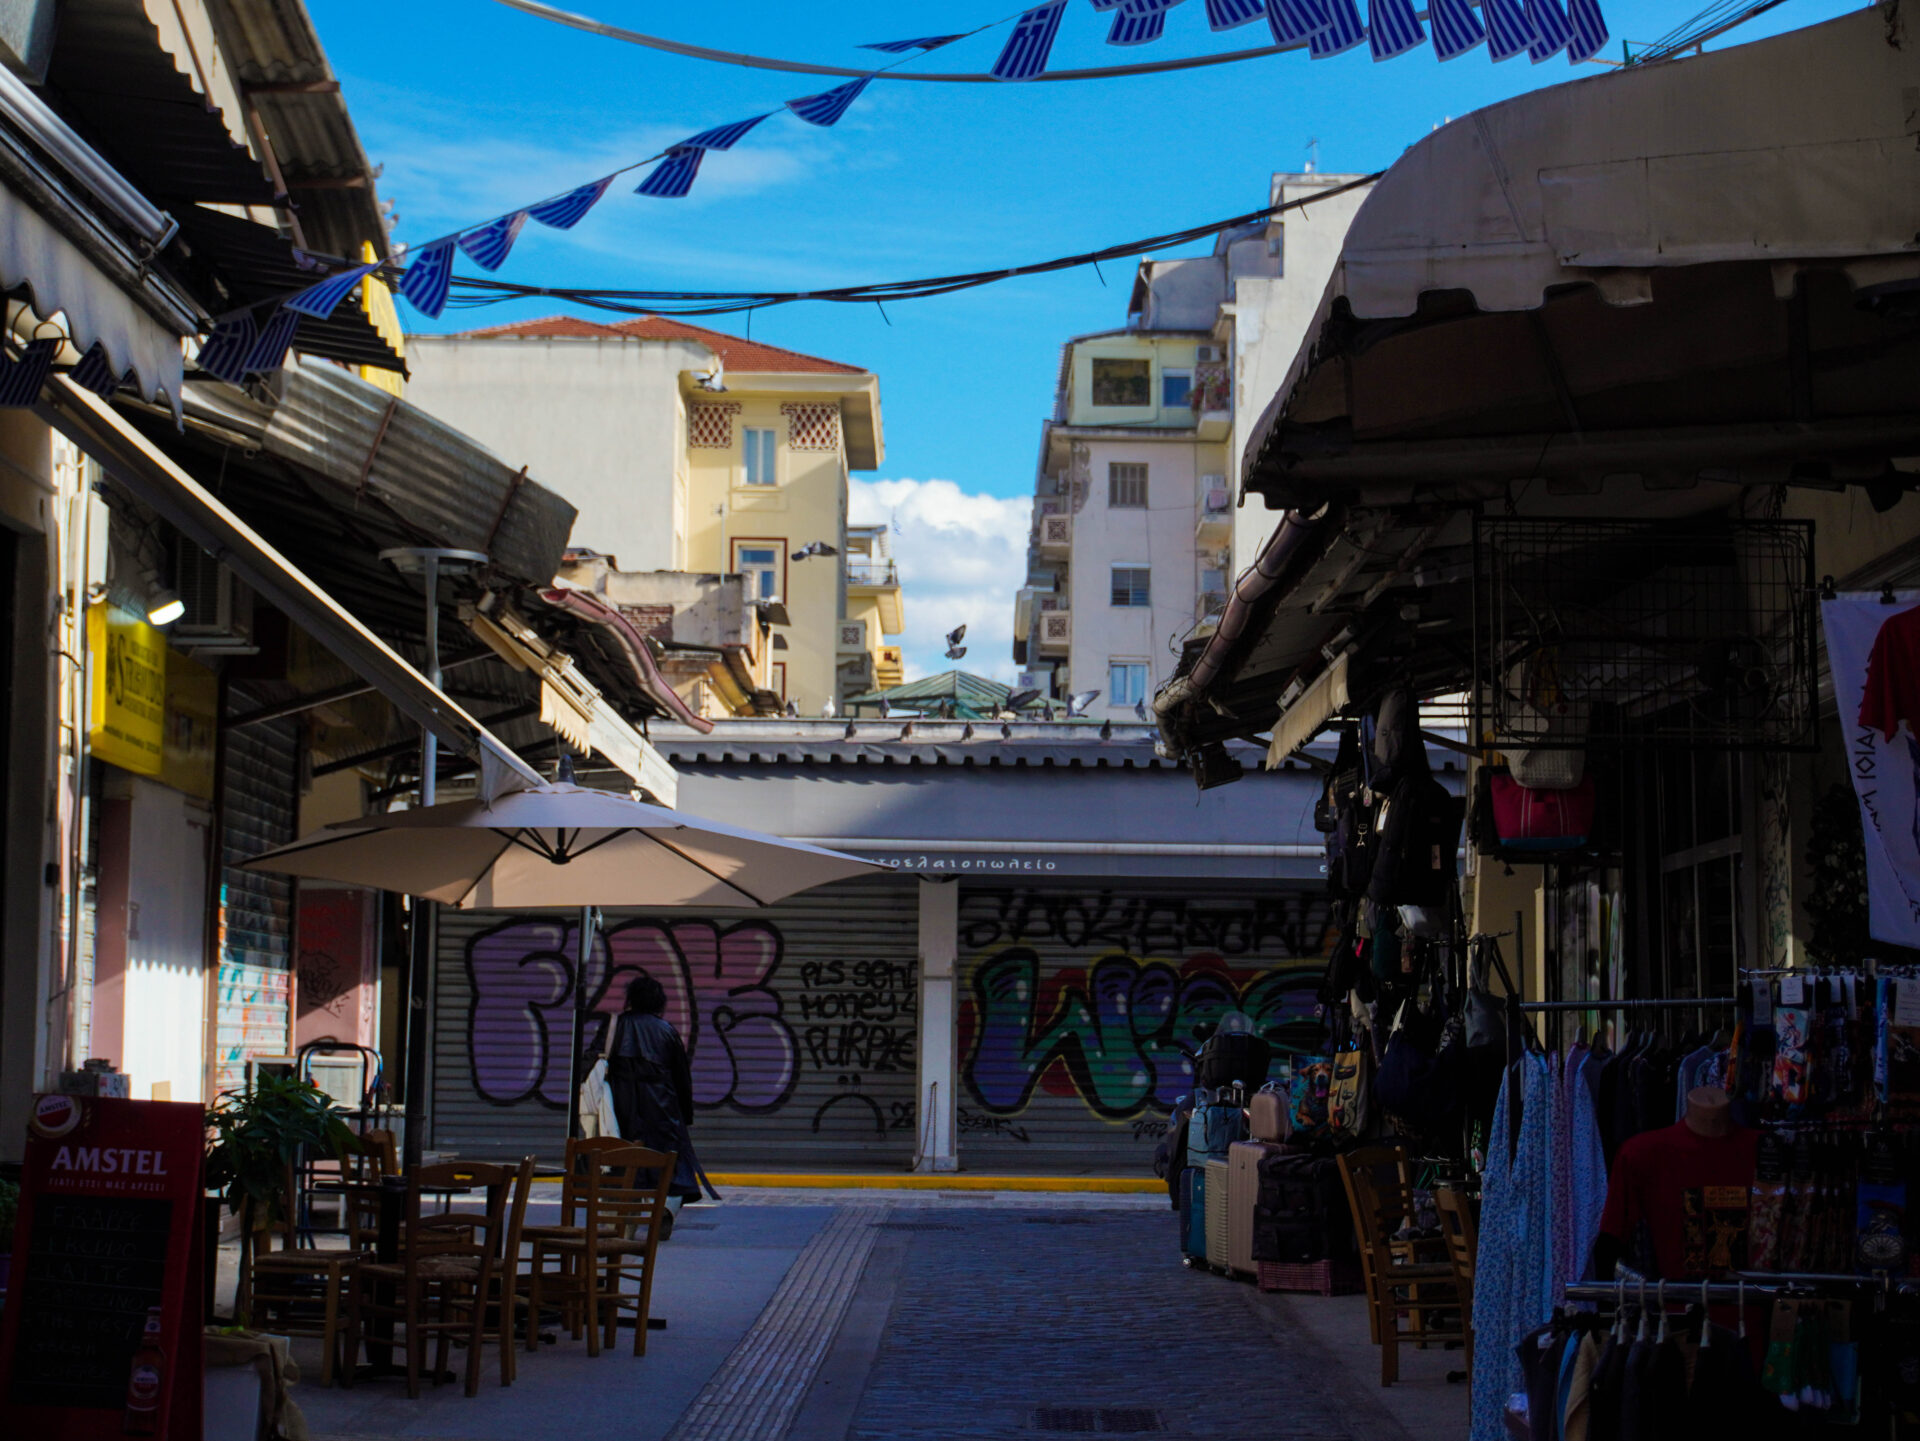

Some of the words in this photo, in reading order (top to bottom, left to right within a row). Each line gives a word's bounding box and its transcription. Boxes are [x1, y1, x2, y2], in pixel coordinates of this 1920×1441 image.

[801, 960, 845, 988] PLS
[39, 1101, 69, 1114] AMSTEL
[51, 1146, 168, 1176] AMSTEL
[105, 1180, 126, 1190] ΜΑΣ
